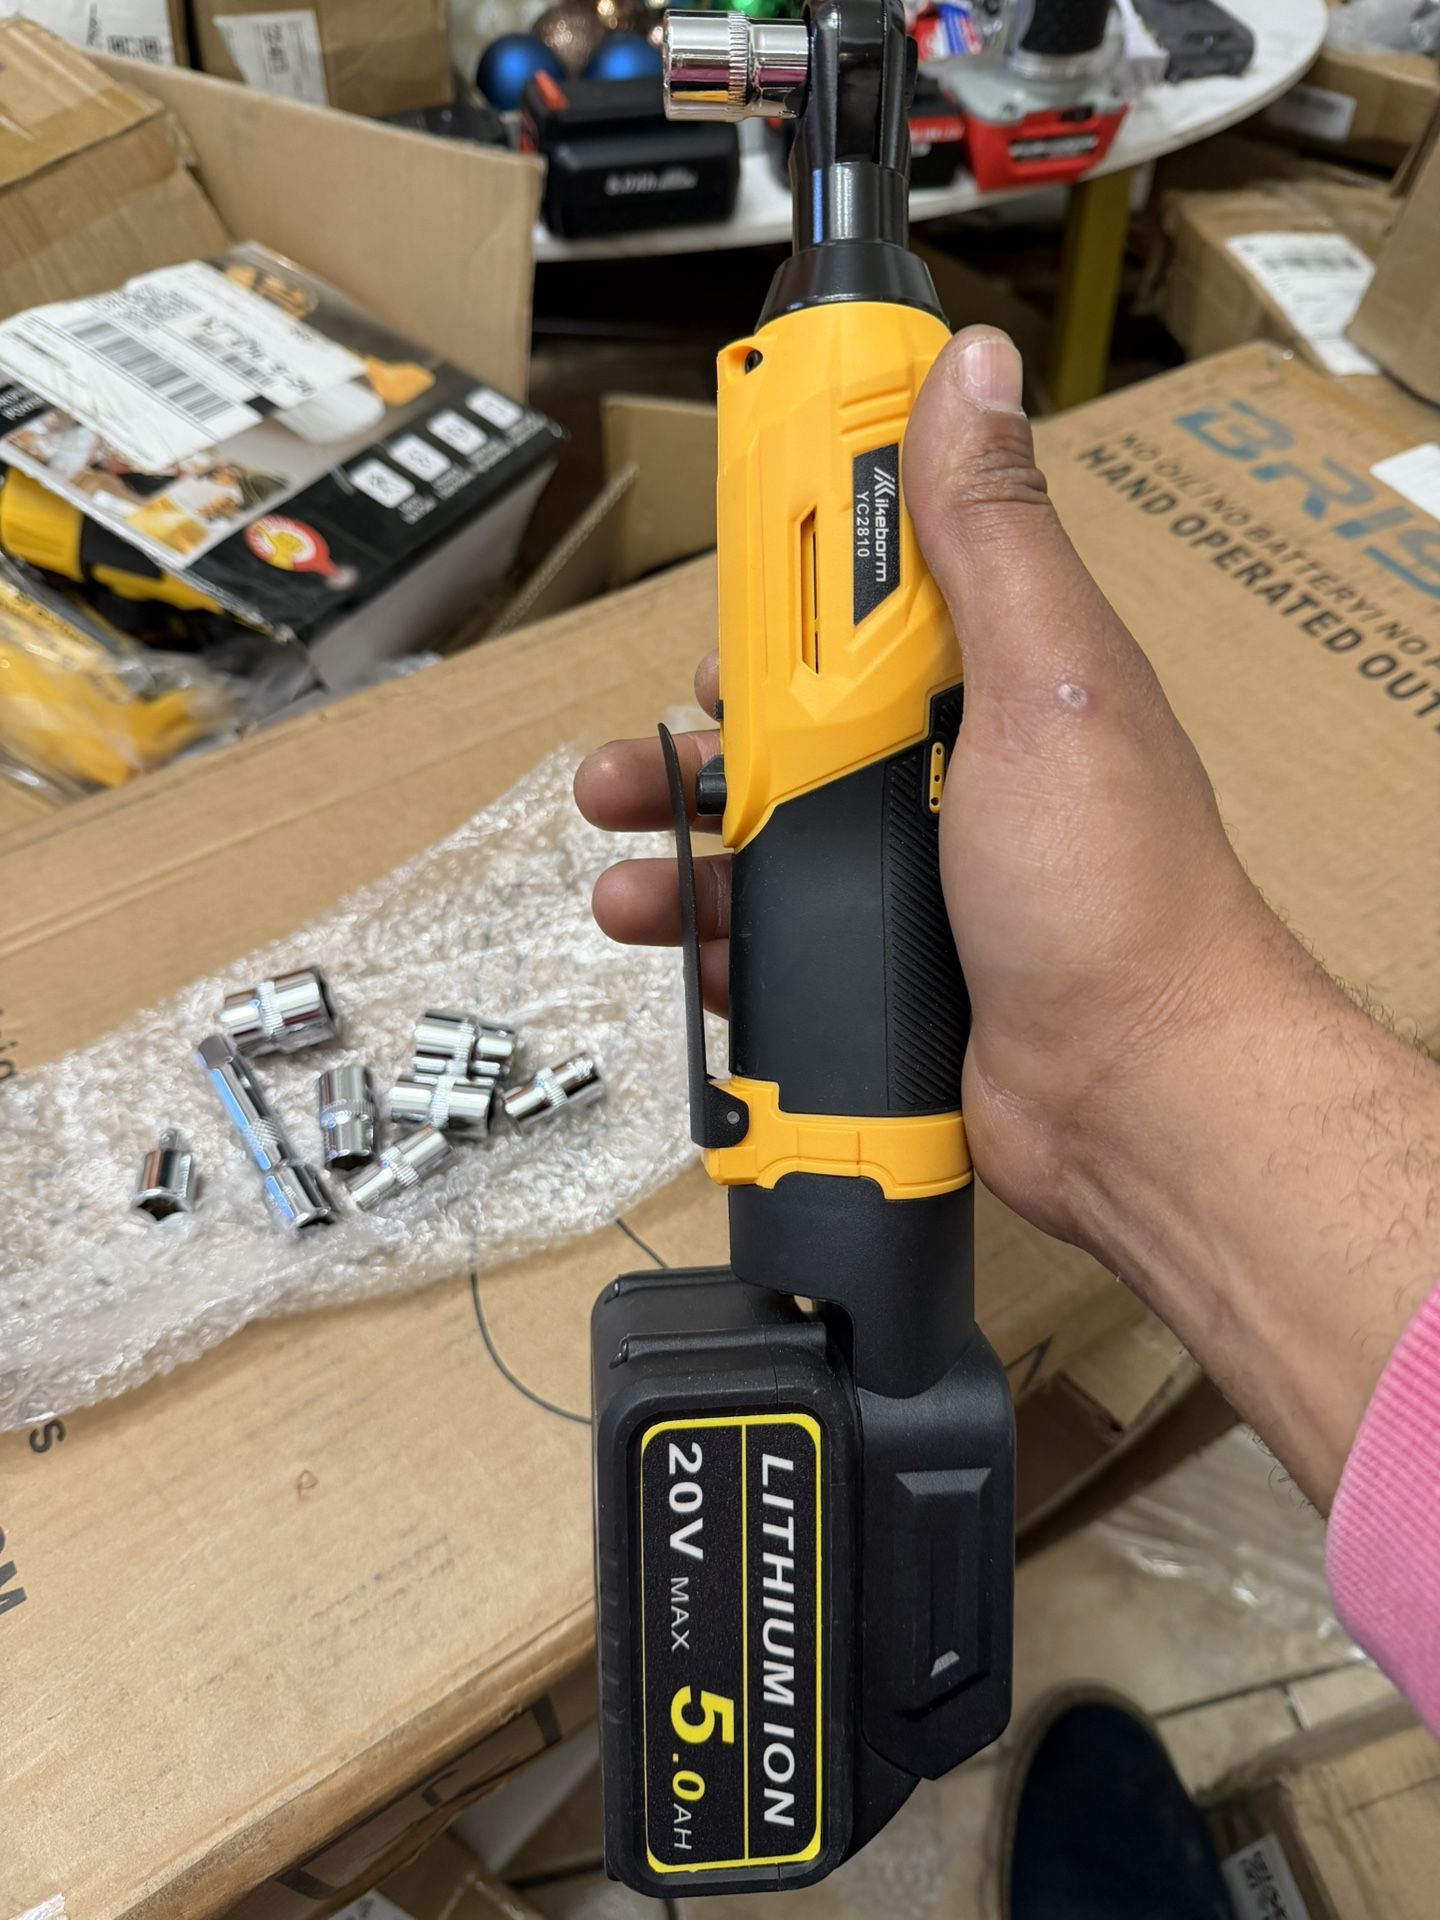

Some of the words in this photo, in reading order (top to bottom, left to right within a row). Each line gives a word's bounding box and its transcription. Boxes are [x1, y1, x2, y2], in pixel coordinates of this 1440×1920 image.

[856, 490, 870, 558] YC2810
[1120, 433, 1160, 462] NO
[1202, 495, 1252, 527] NO
[1374, 620, 1429, 655] NO
[1075, 446, 1178, 515] HAND
[1169, 513, 1365, 654] OPERATED
[1358, 653, 1440, 737] OUT
[668, 1441, 704, 1561] 20V
[670, 1576, 690, 1651] MAX
[761, 1453, 795, 1707] LITHIUM
[762, 1722, 796, 1827] ION
